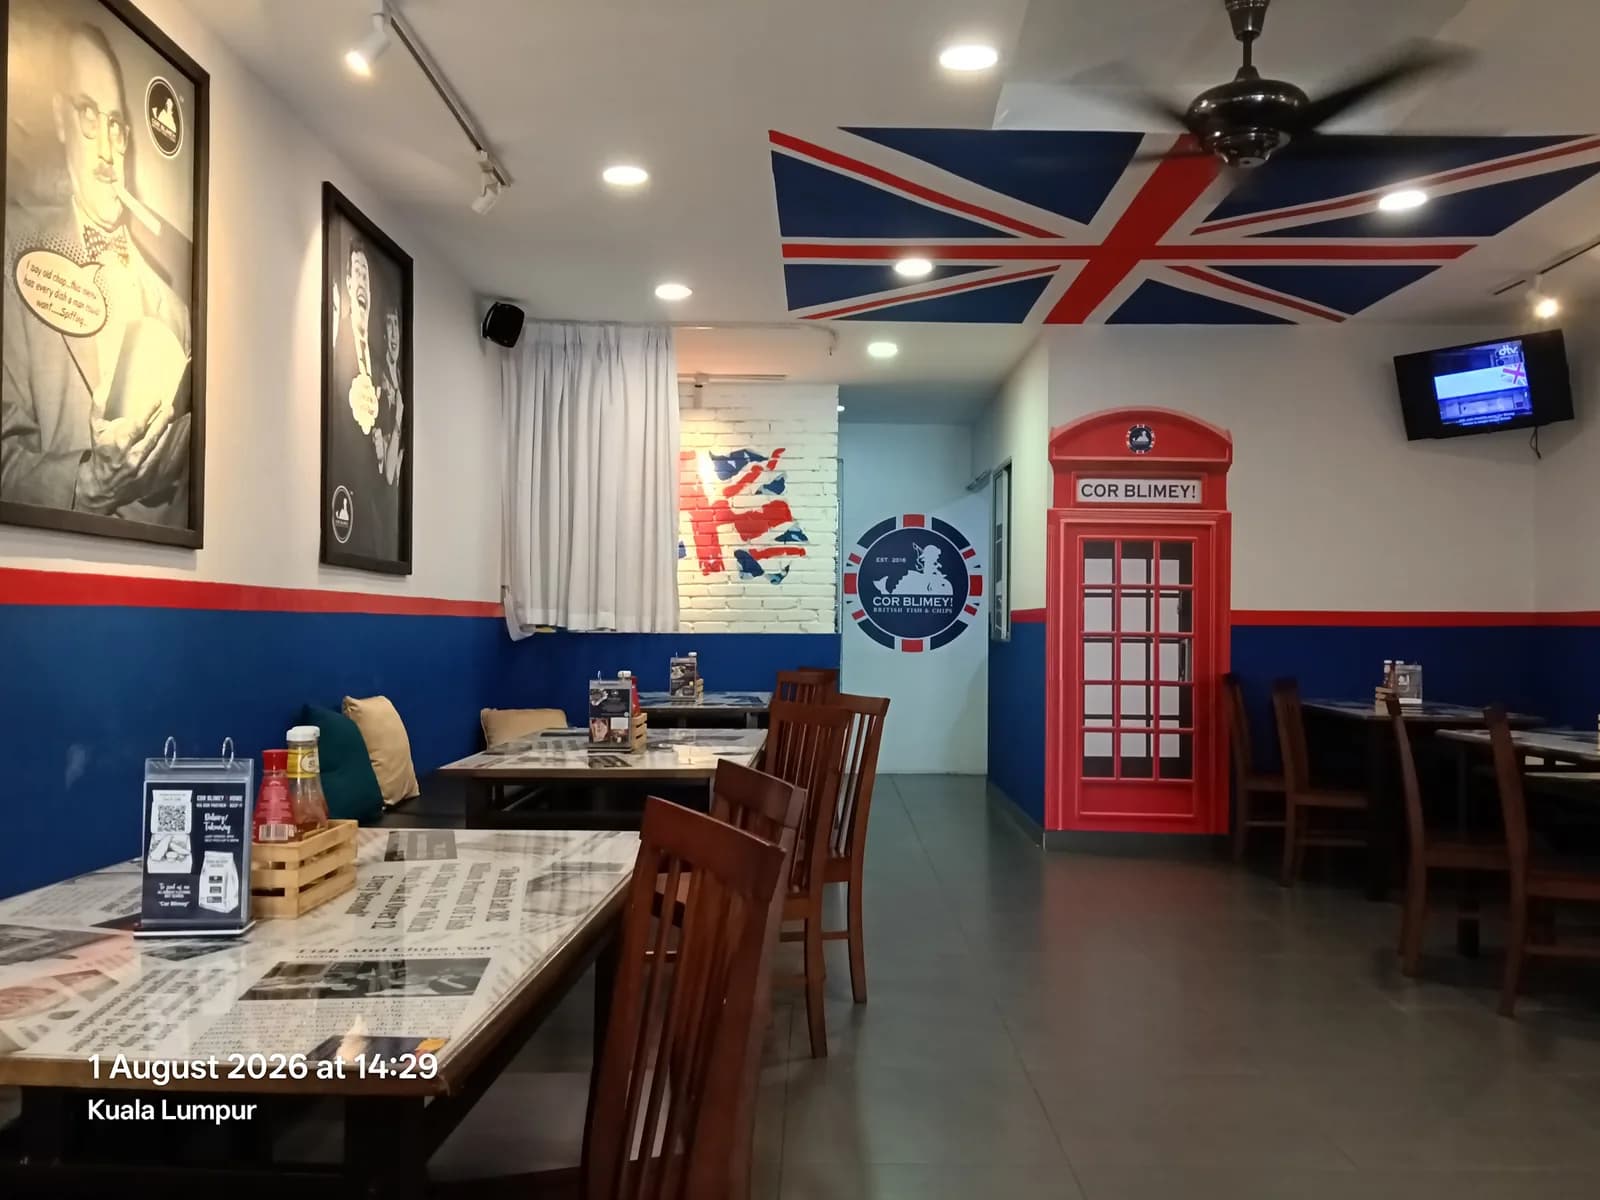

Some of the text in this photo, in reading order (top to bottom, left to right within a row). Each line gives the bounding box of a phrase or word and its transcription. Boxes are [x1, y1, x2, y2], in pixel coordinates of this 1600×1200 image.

[35, 284, 54, 298] every
[1081, 483, 1196, 499] COR BLIMEY!
[872, 596, 953, 608] COR BLIMEY!
